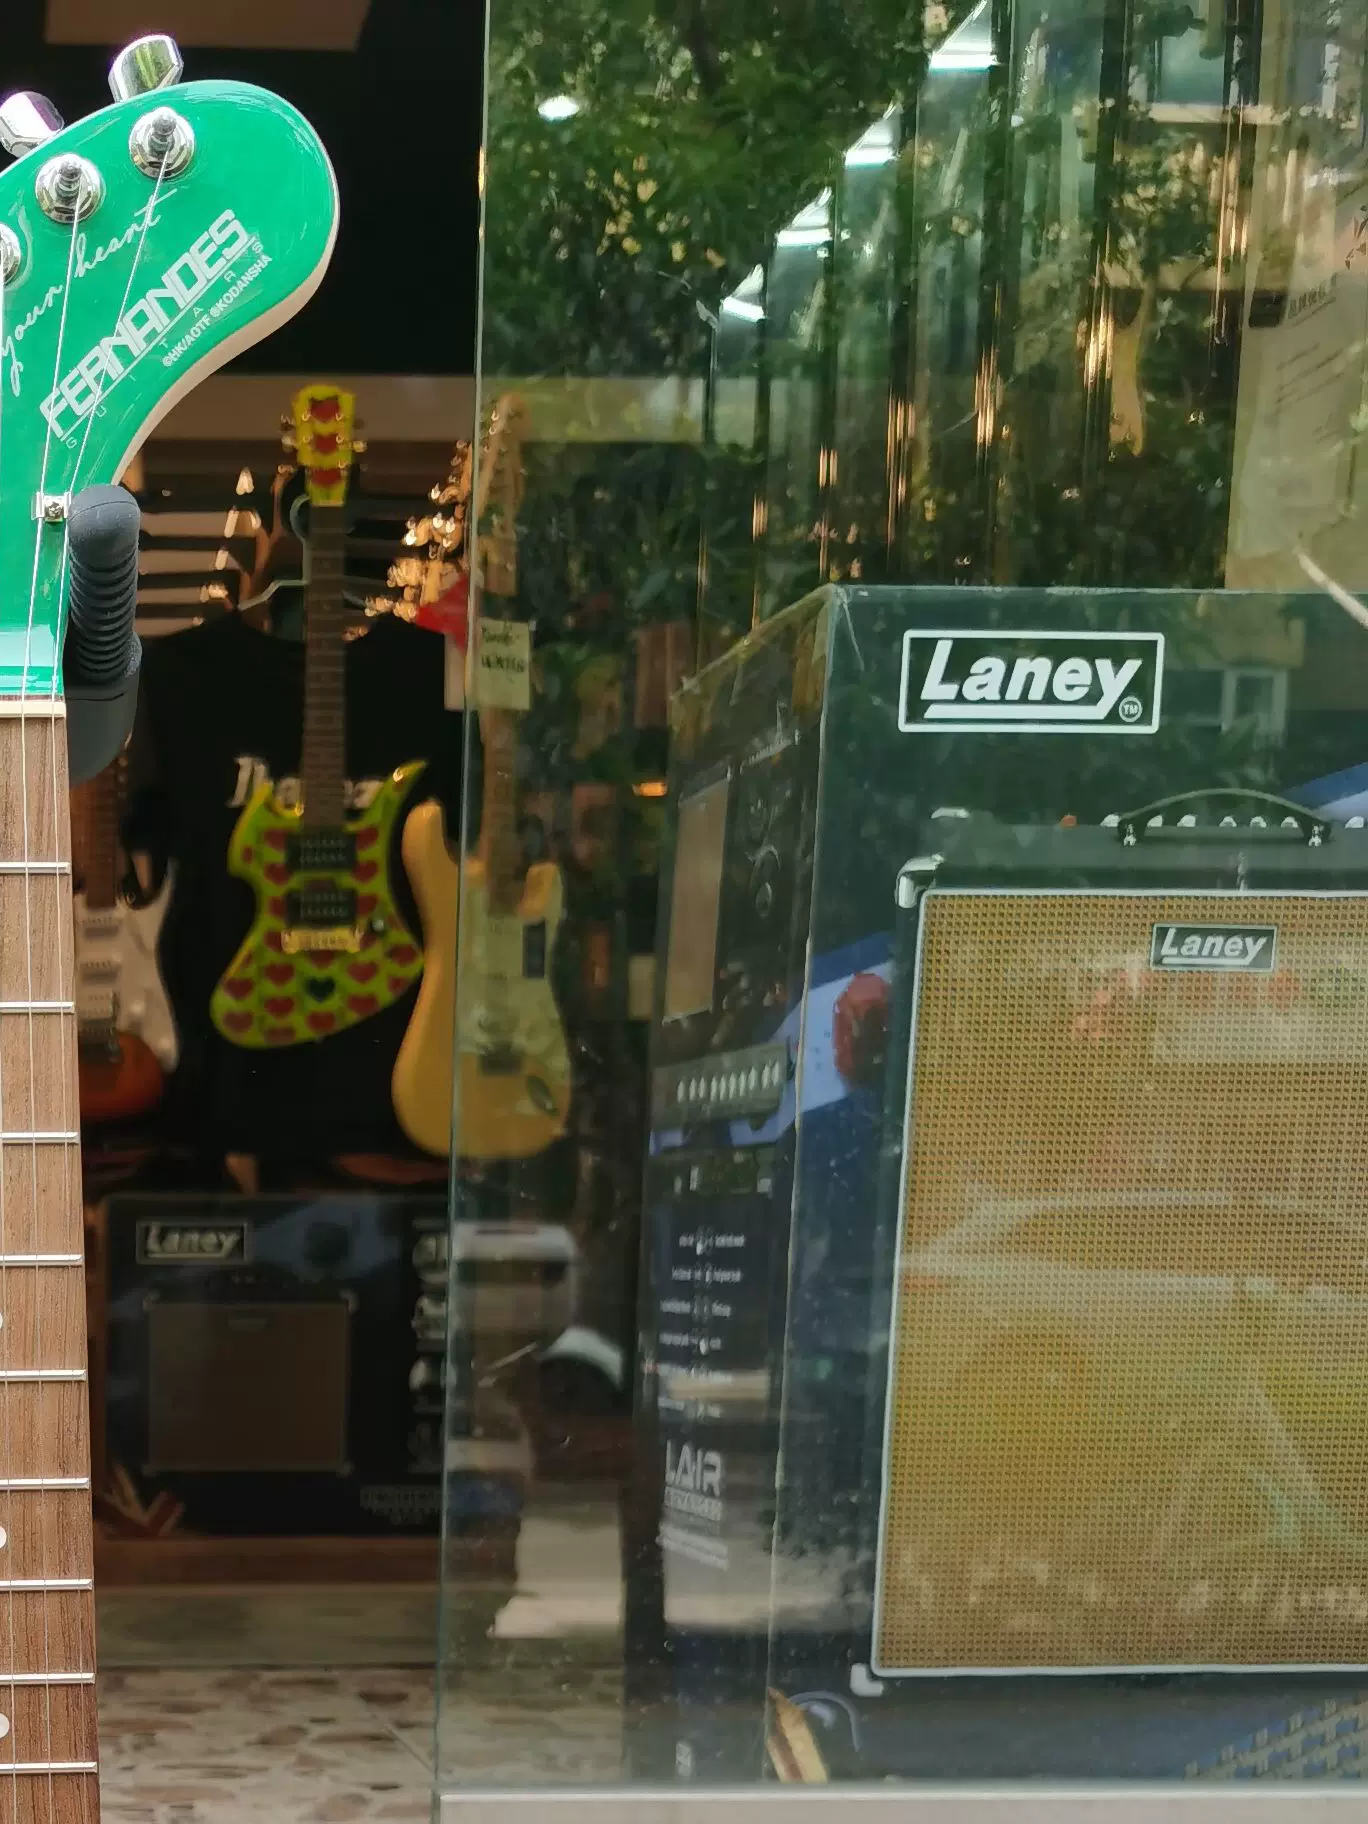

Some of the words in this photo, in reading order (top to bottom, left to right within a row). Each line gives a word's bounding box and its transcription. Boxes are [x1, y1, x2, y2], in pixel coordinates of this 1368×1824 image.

[0, 284, 64, 397] your
[74, 188, 178, 278] heart
[39, 209, 251, 439] FERNANDES
[920, 639, 1143, 720] Laney
[1160, 927, 1267, 967] Laney
[146, 1221, 241, 1259] Laney
